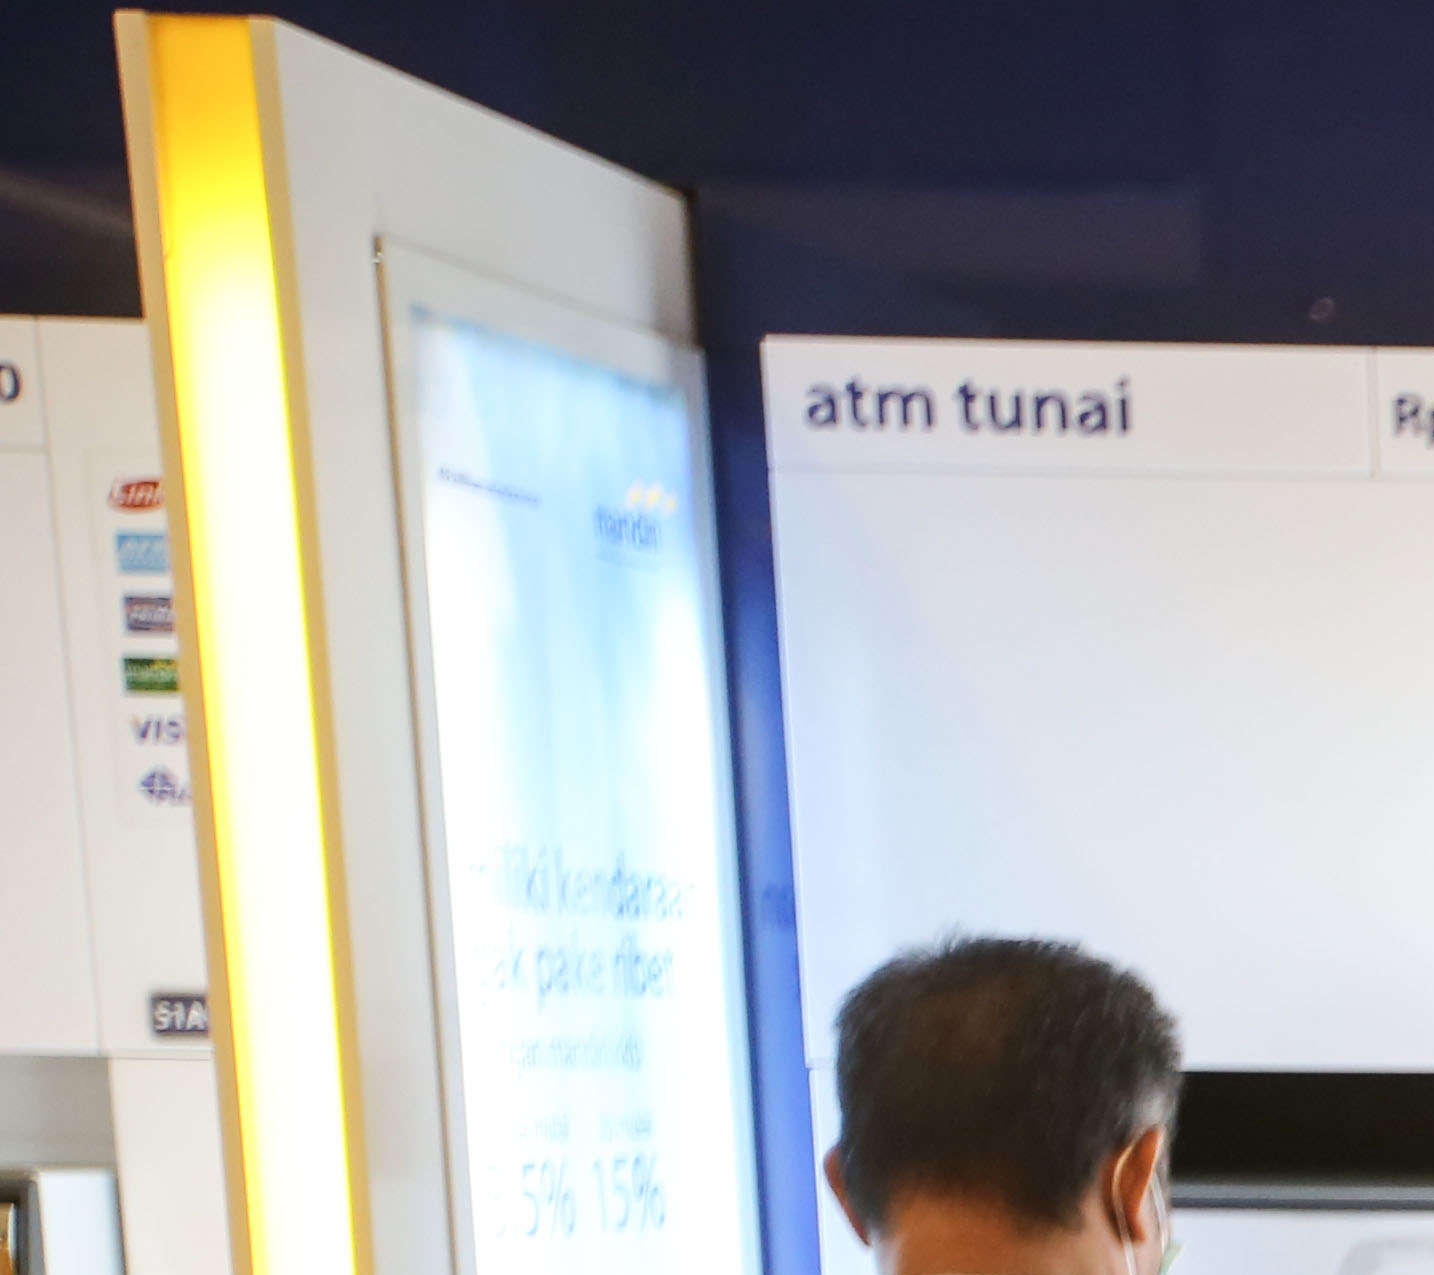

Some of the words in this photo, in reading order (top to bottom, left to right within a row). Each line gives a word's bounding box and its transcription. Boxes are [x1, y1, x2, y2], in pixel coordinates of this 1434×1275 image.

[806, 379, 935, 429] atm
[957, 379, 1130, 434] tunai
[131, 715, 187, 745] VIS
